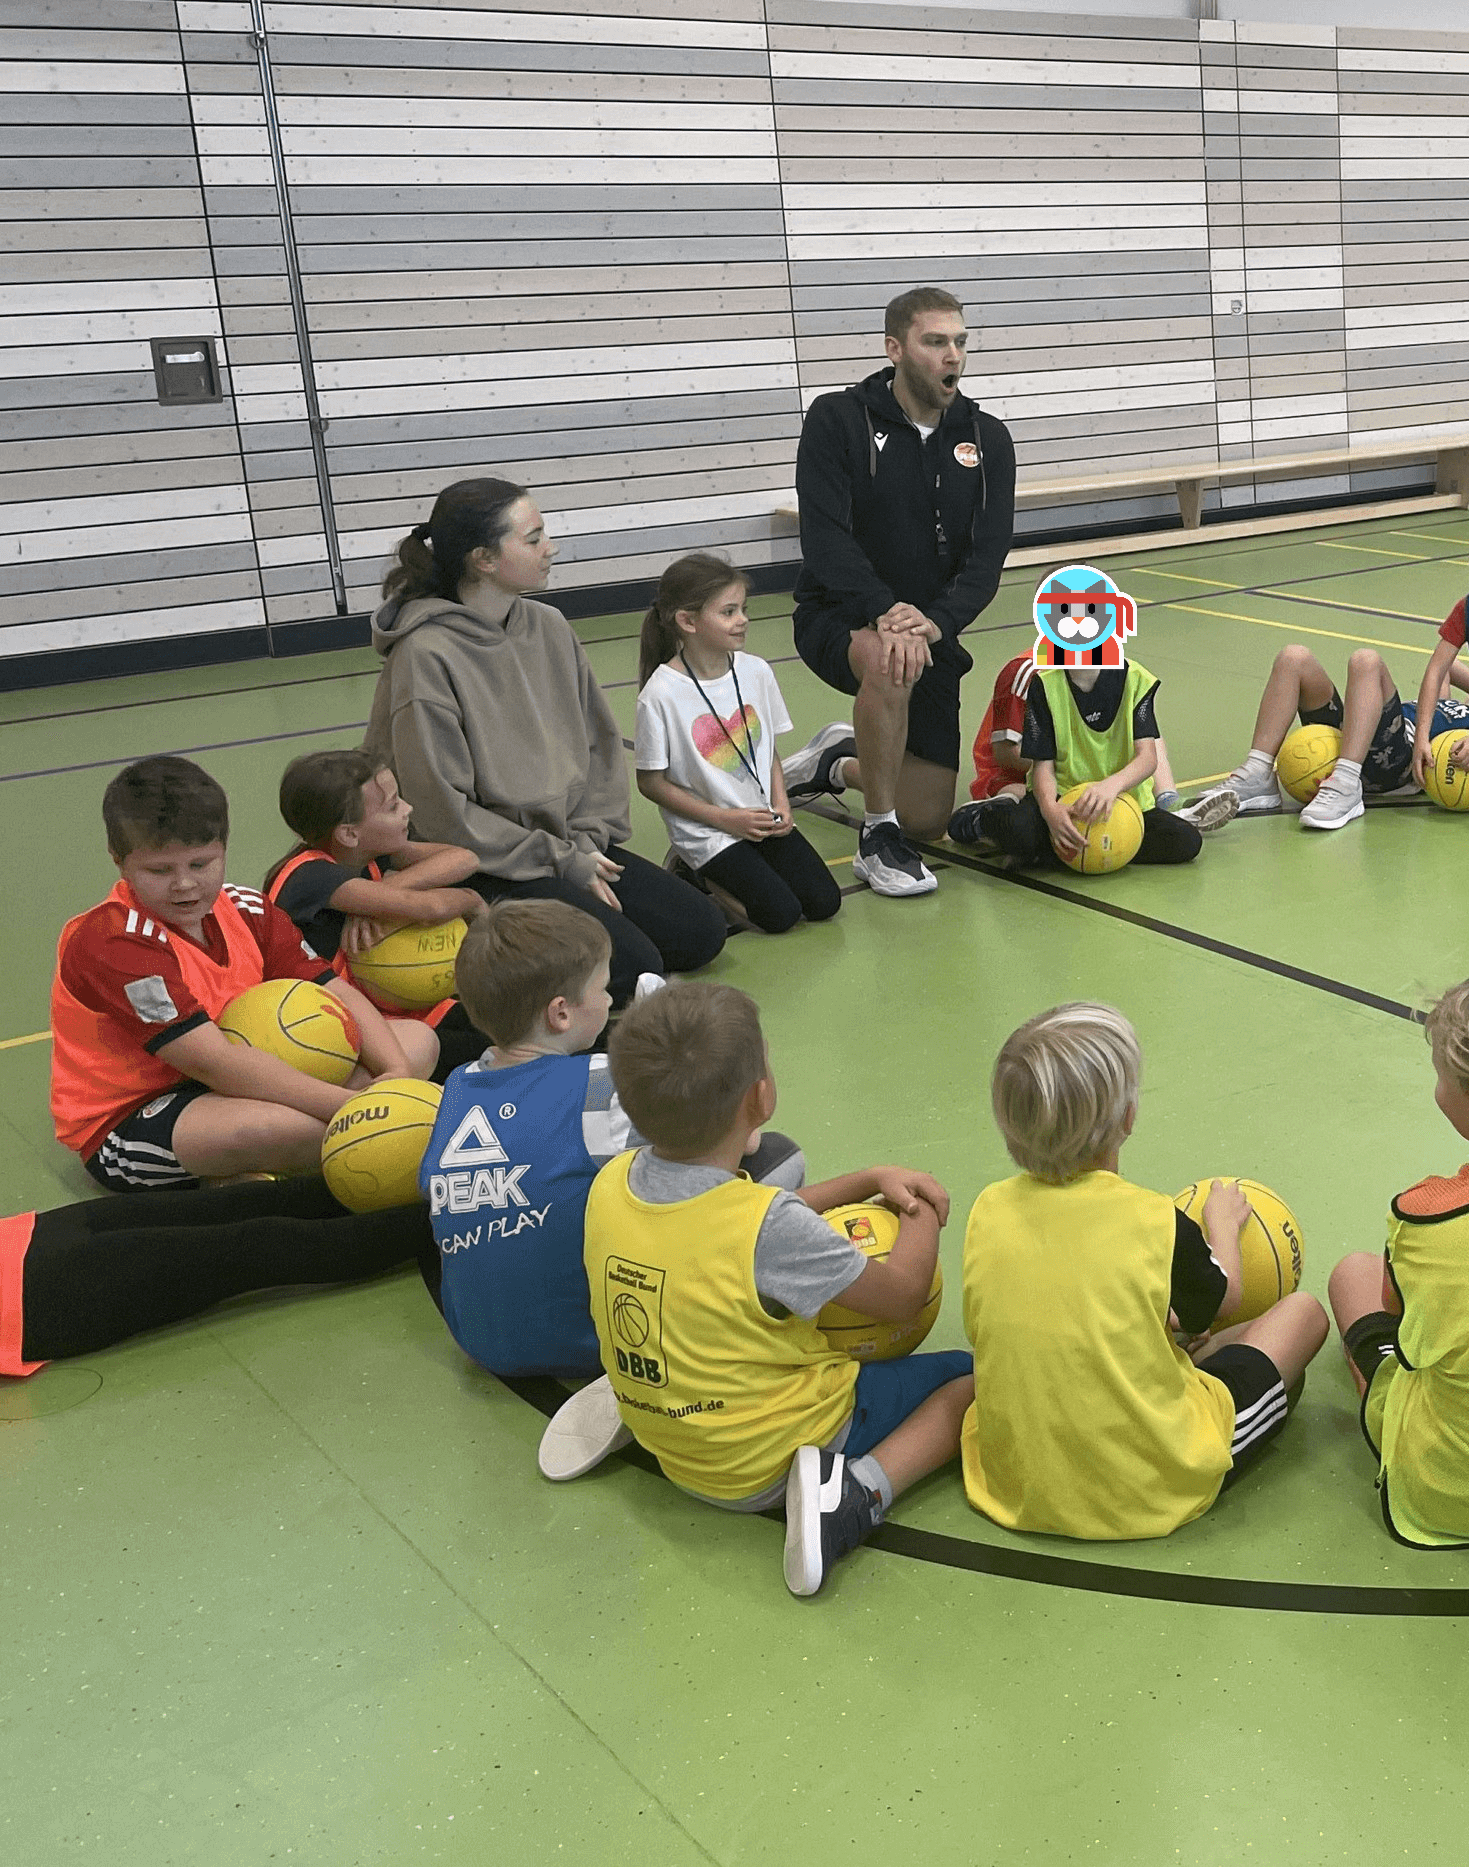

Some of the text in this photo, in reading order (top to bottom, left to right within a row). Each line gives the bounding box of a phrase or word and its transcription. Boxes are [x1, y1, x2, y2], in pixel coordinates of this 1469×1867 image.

[430, 1165, 532, 1216] PEAK
[442, 1202, 553, 1254] CAN PLAY
[615, 1346, 662, 1384] DBB
